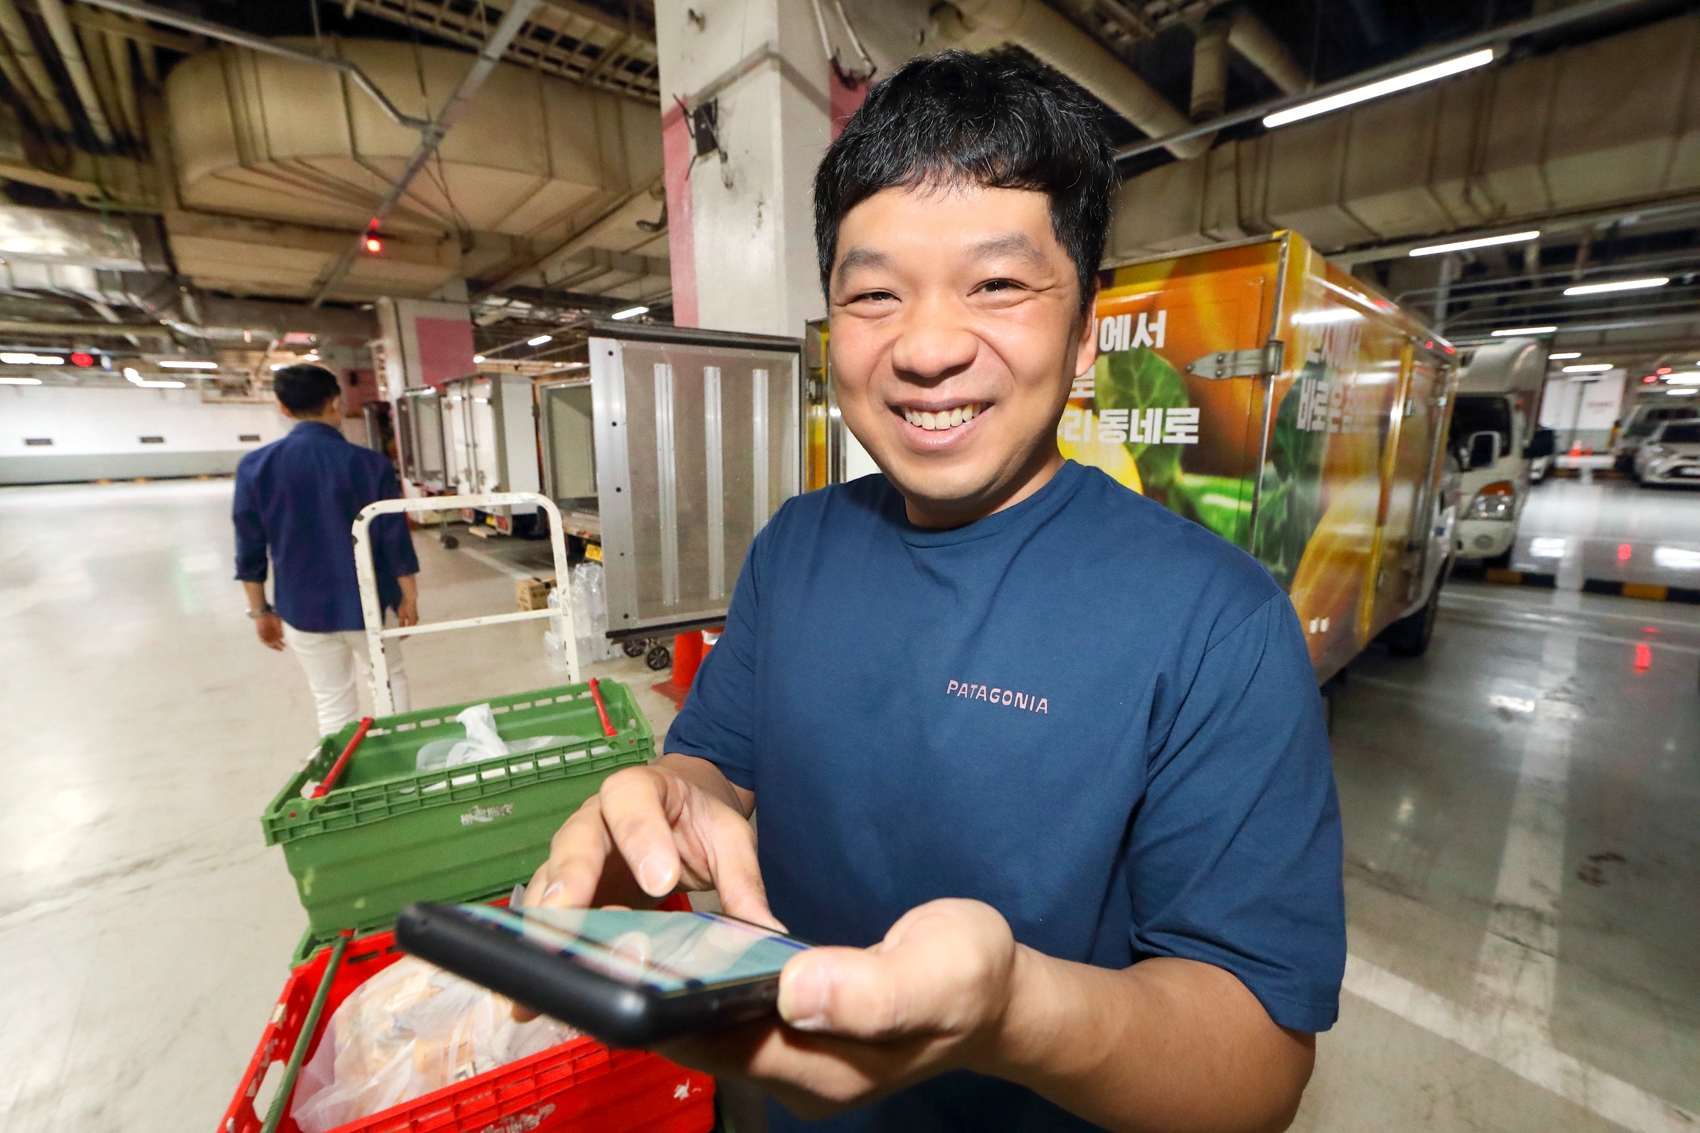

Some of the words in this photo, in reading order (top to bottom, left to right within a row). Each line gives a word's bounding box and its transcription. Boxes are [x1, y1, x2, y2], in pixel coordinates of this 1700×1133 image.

[1095, 310, 1167, 352] 에서
[1057, 409, 1093, 442] 리
[1097, 407, 1200, 444] 동네로
[946, 679, 1049, 714] PATAGONIA
